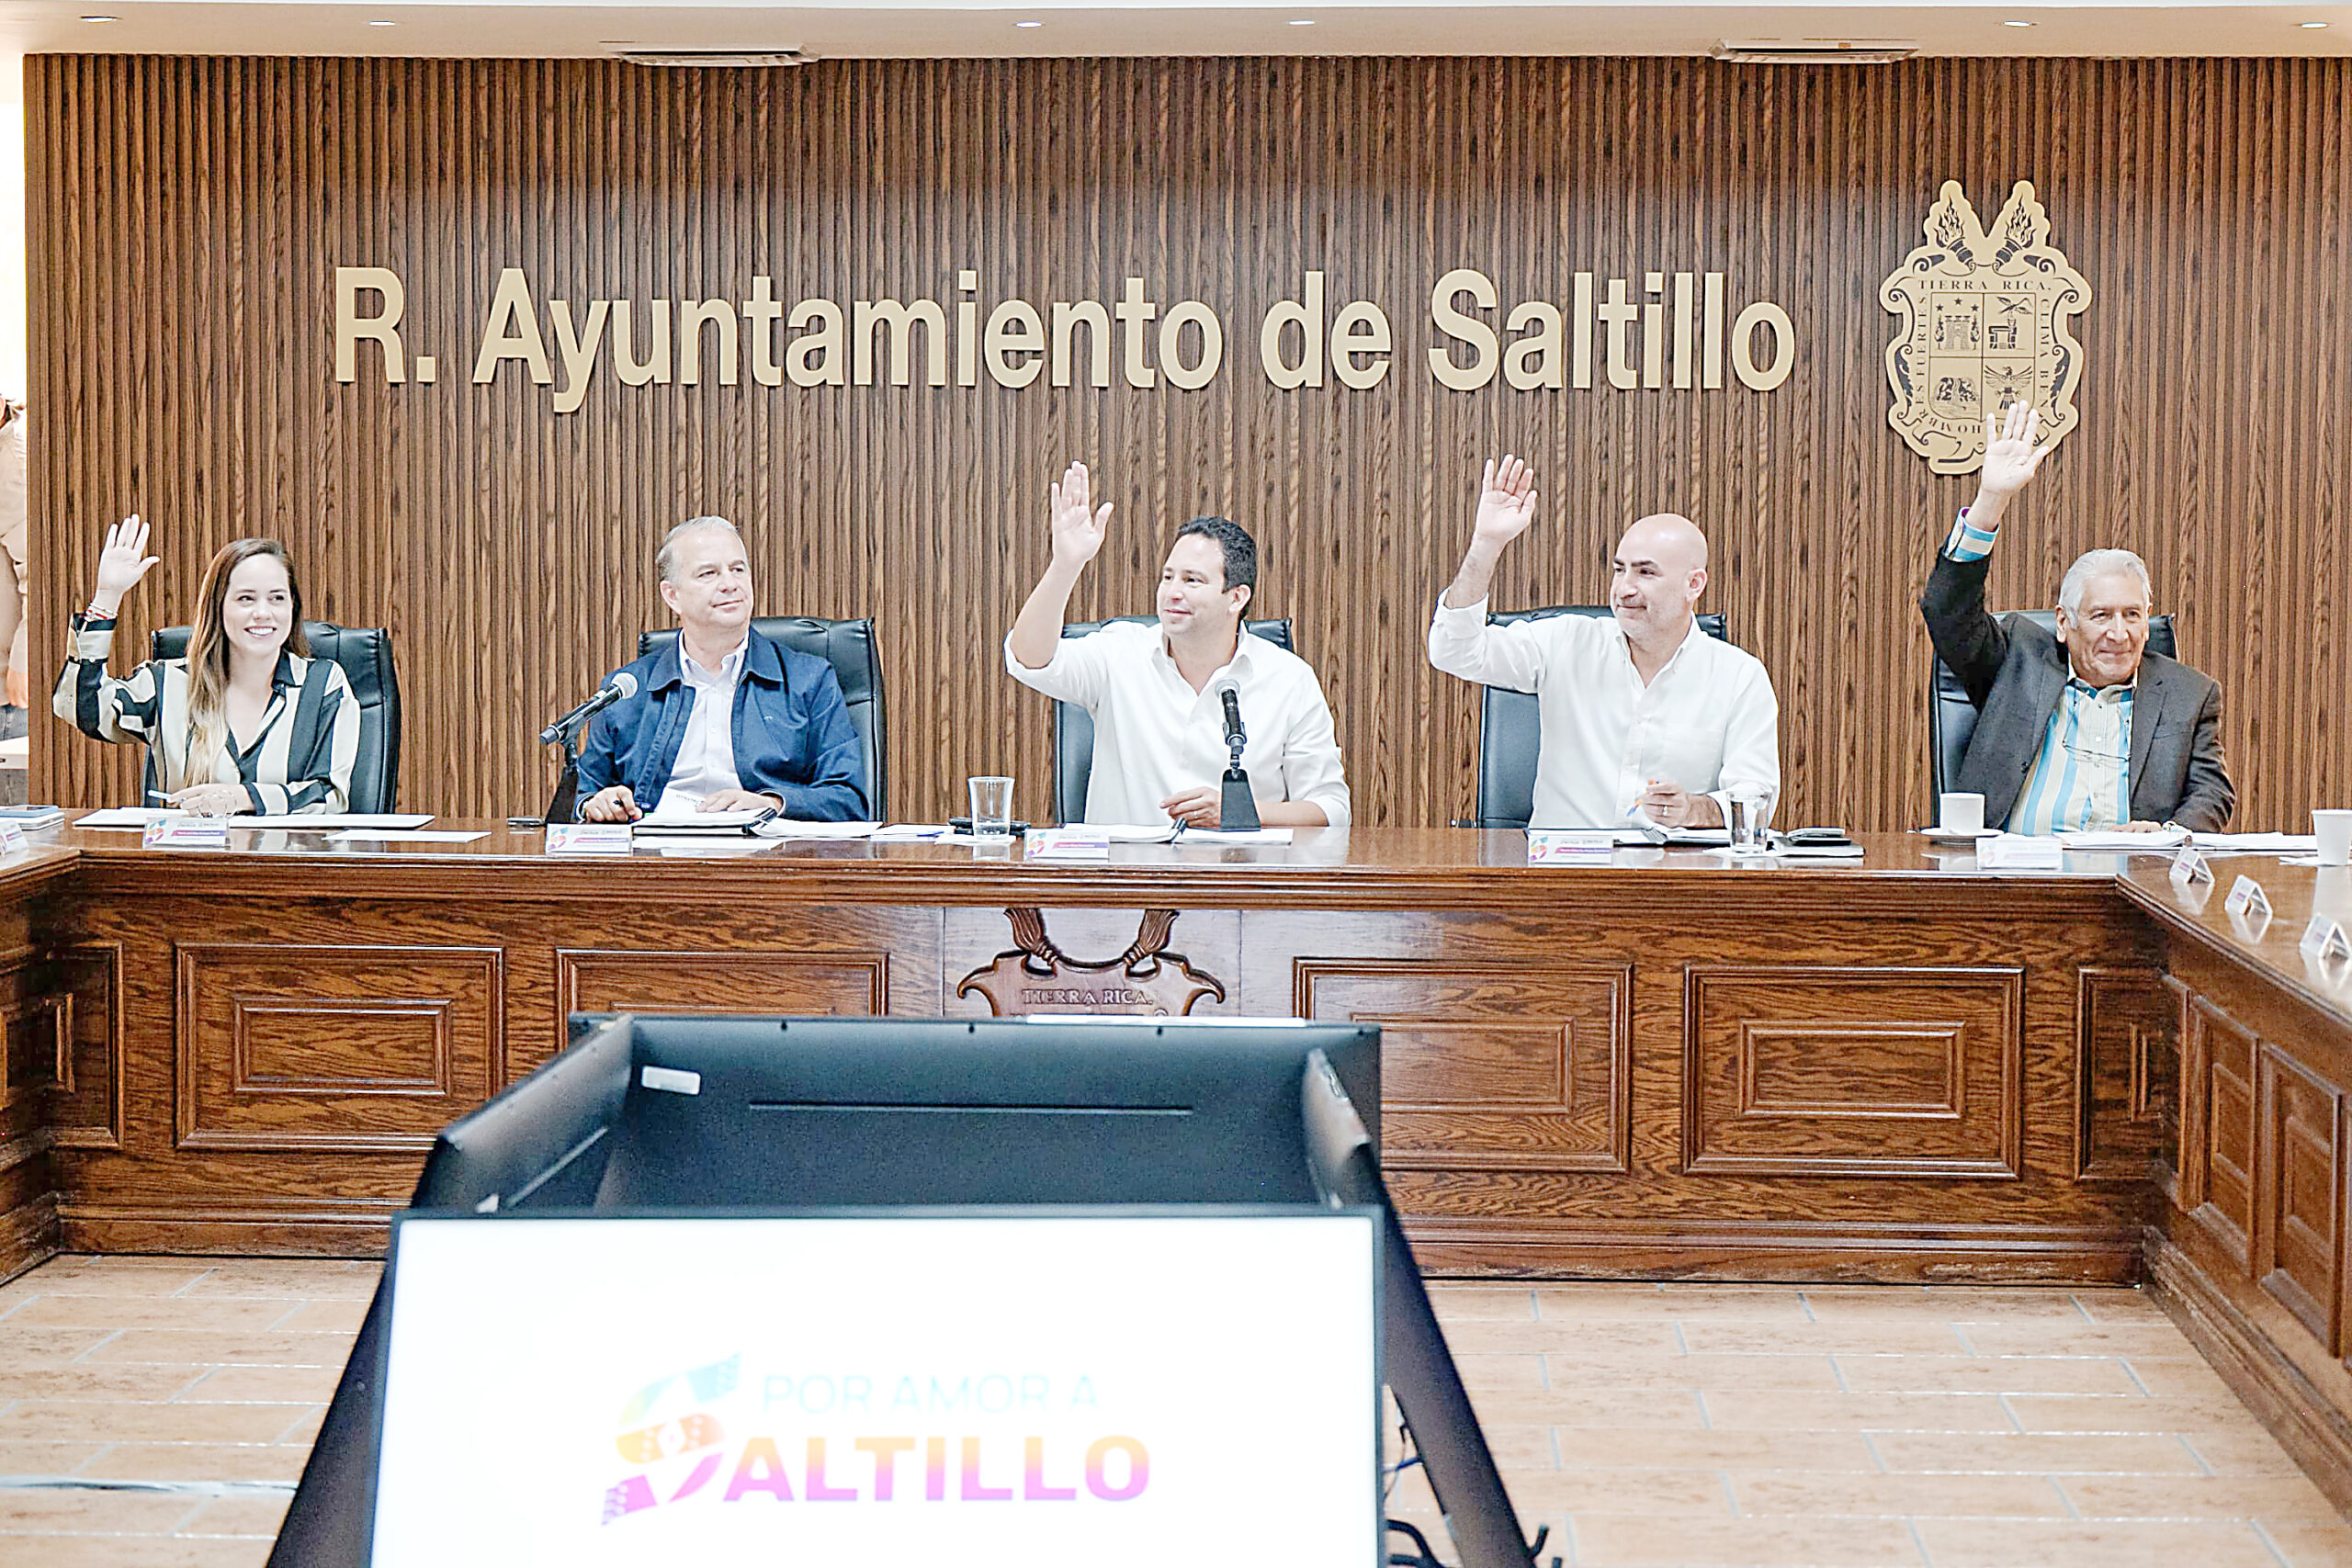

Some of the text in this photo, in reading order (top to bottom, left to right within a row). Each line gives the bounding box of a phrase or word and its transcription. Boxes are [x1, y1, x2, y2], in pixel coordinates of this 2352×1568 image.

[1917, 279, 1988, 291] TIERRA
[334, 266, 1796, 414] R. Ayuntamiento de Saltillo
[2040, 299, 2051, 358] CLIMA
[1915, 385, 1982, 434] HOMBRES
[1021, 987, 1099, 1006] TIERRA
[762, 1373, 1100, 1415] POR AMOR A
